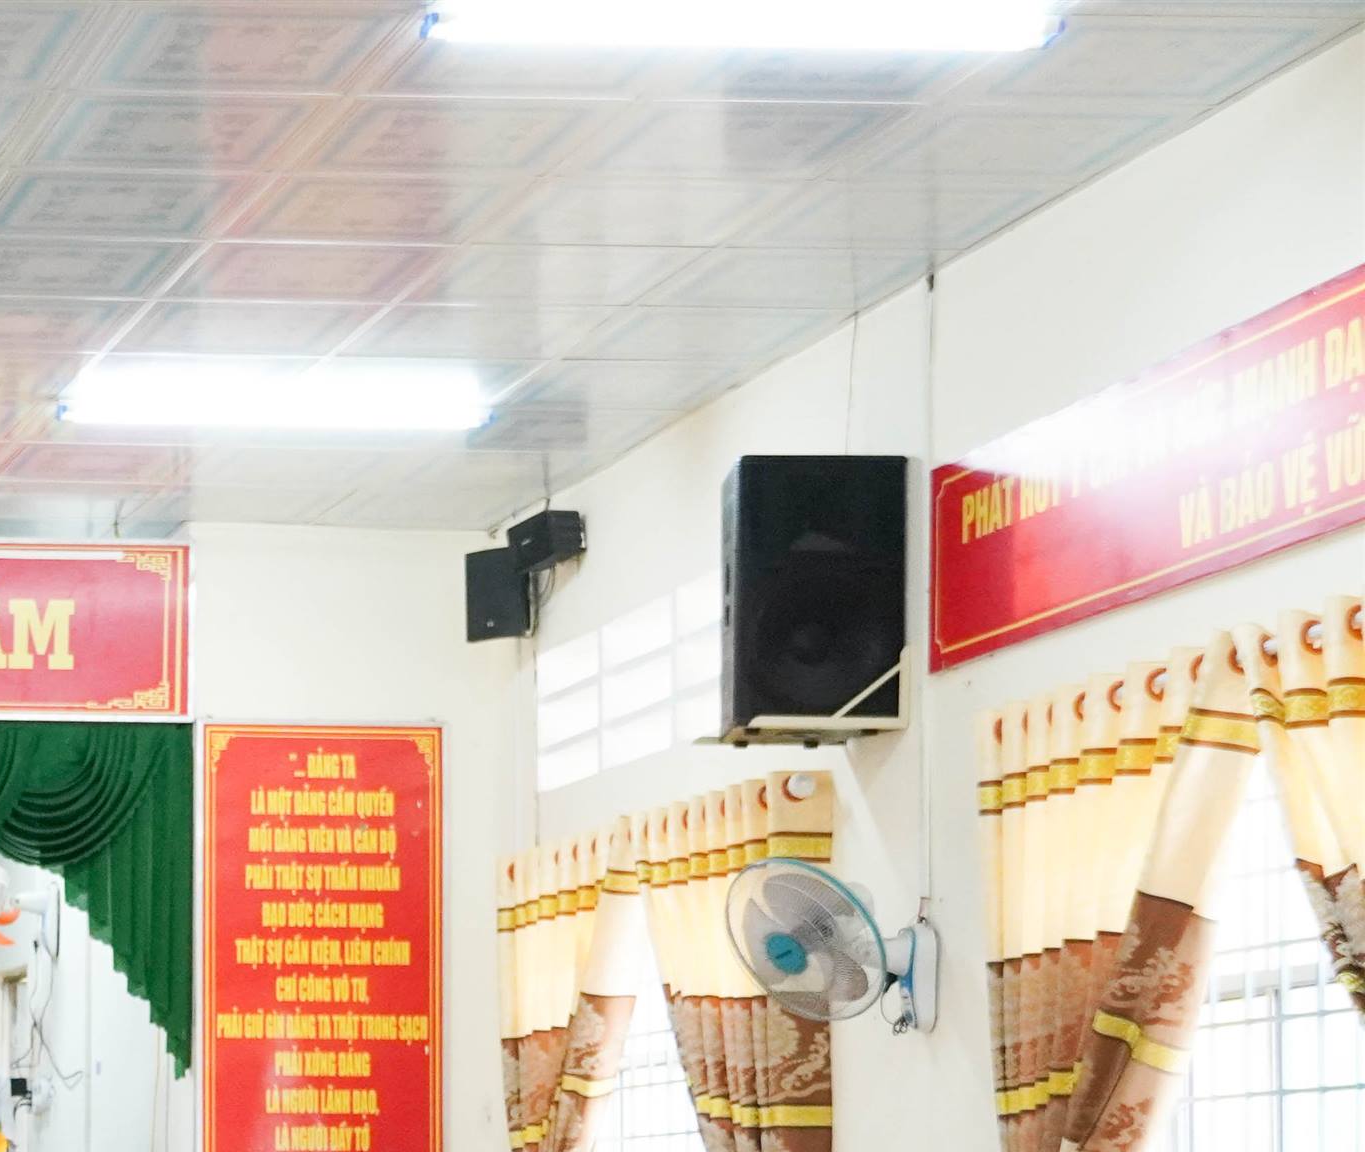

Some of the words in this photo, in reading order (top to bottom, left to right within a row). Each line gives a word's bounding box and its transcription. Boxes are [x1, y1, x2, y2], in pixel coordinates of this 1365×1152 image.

[1324, 318, 1365, 393] ĐẠ
[1179, 476, 1211, 549] VÀ
[1220, 451, 1274, 534] BẢO
[1282, 432, 1318, 514] VỆ
